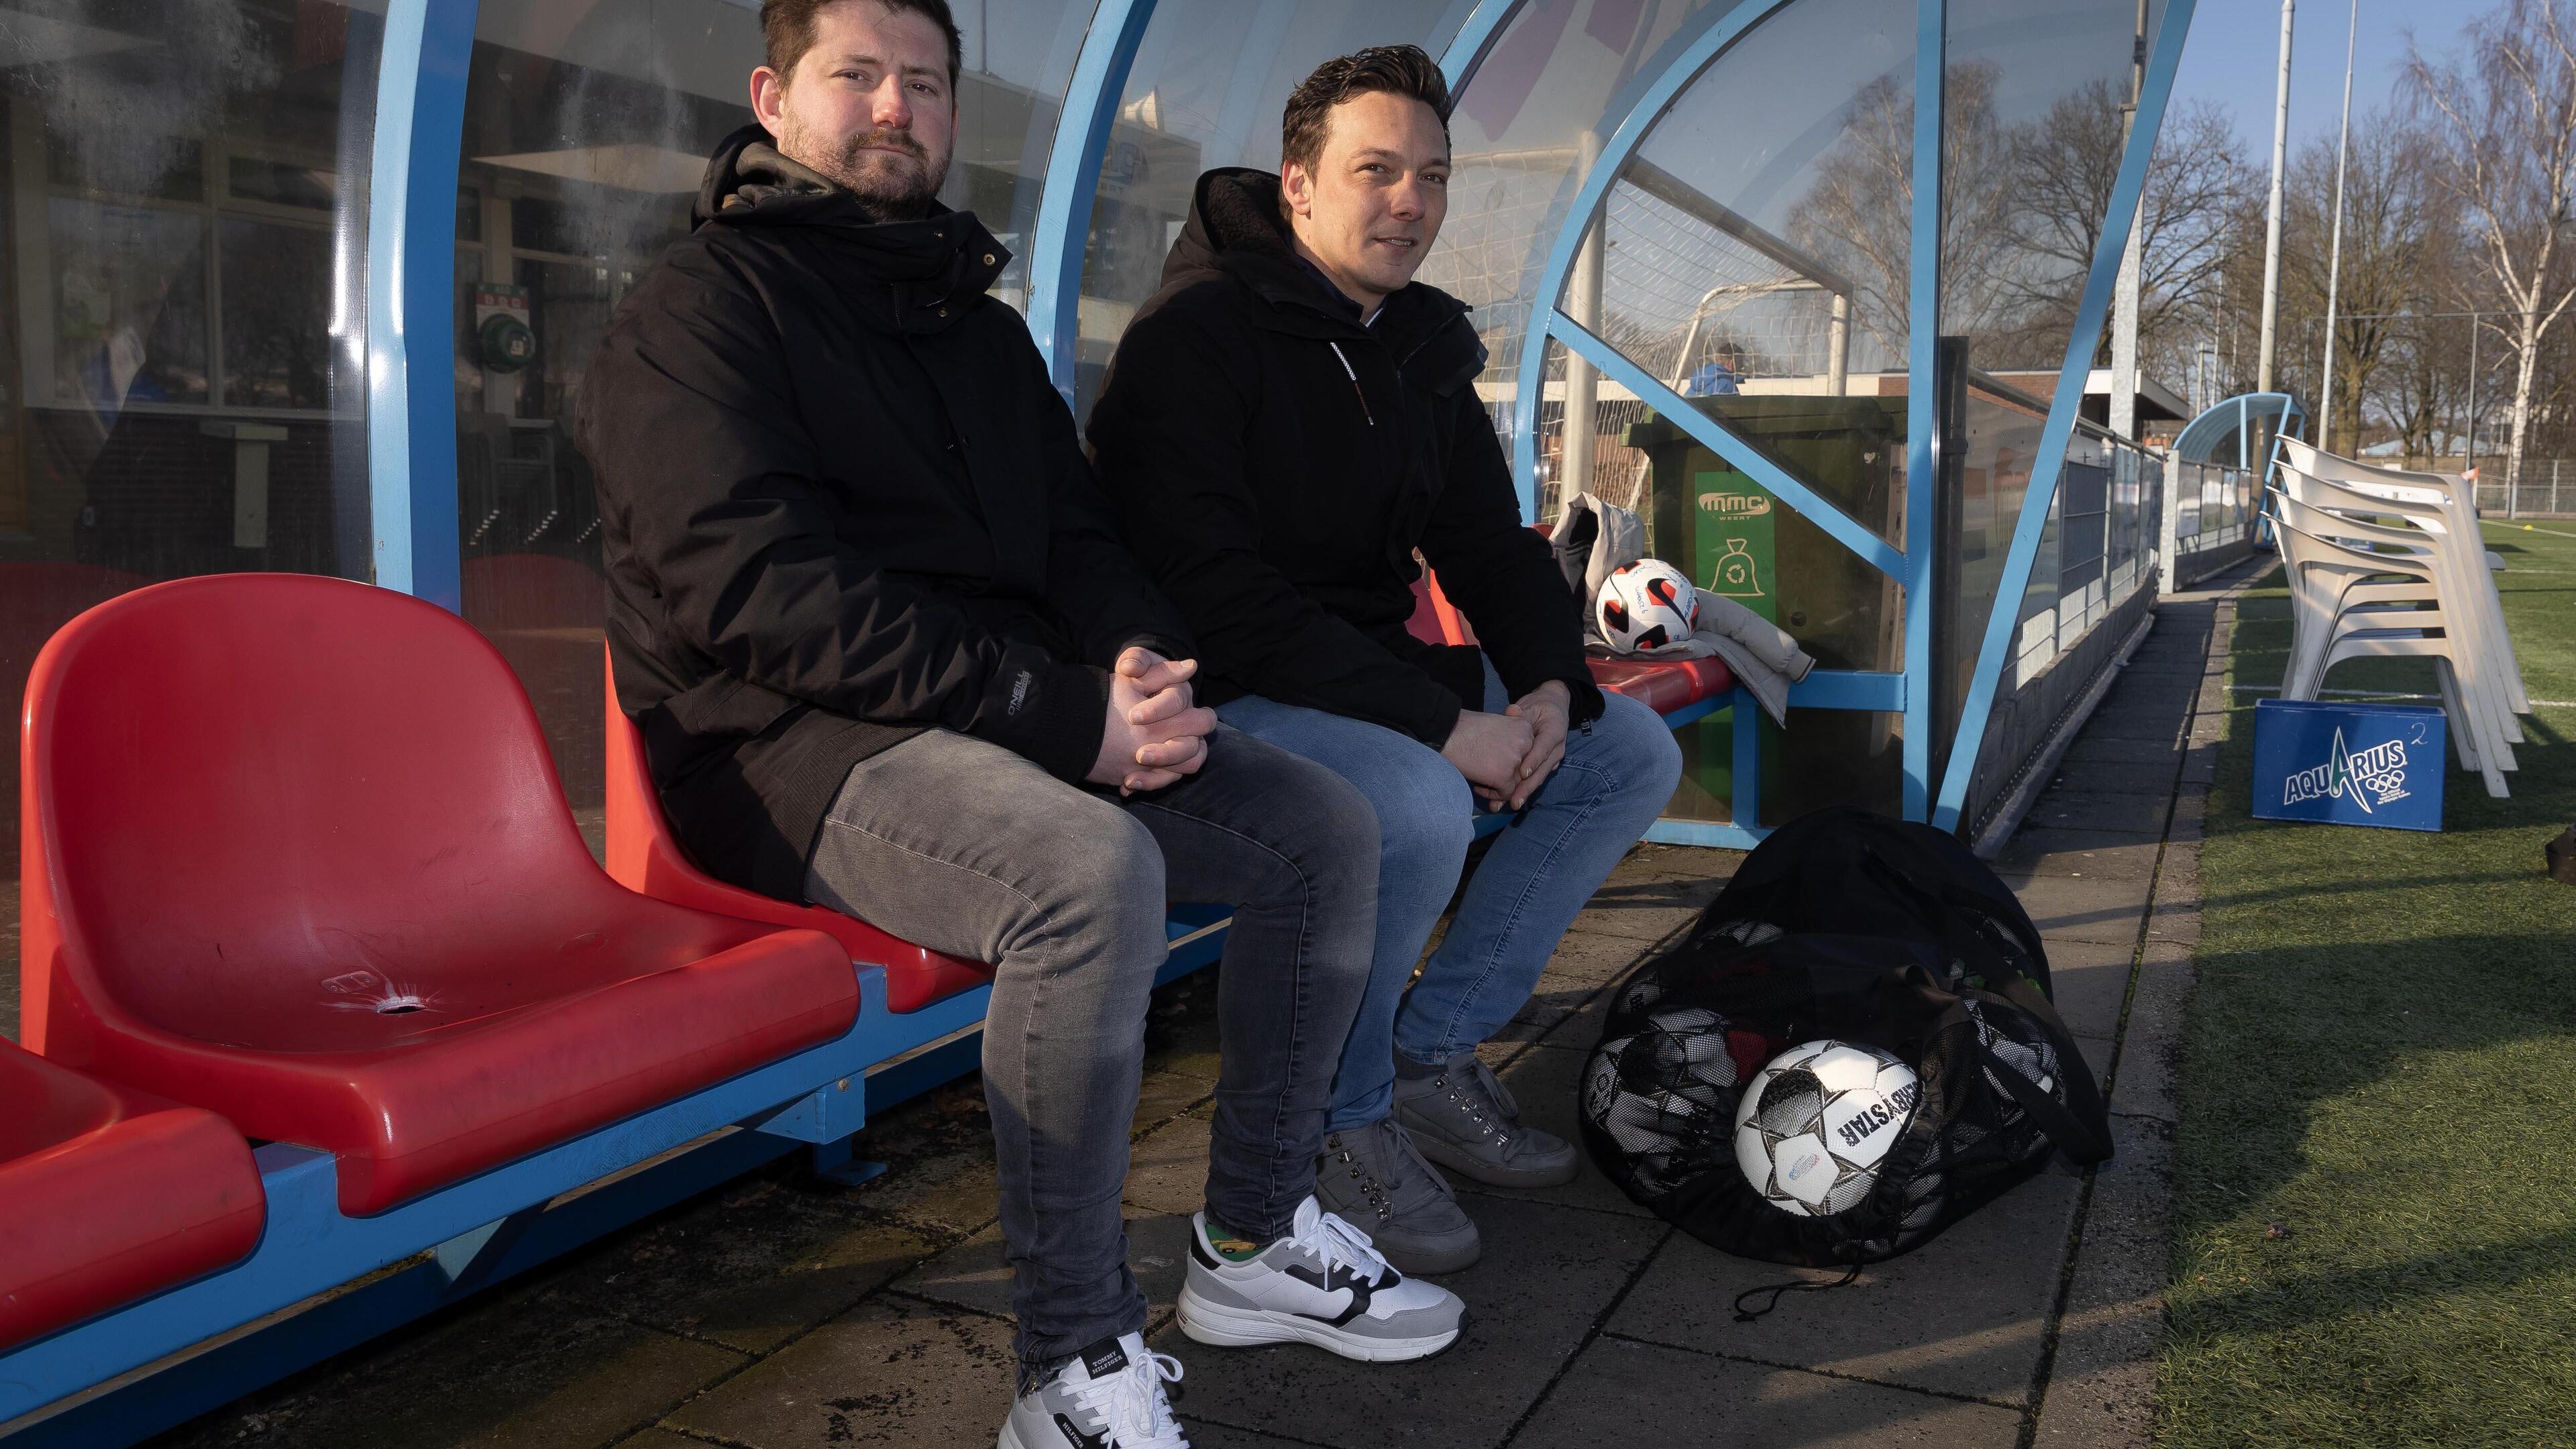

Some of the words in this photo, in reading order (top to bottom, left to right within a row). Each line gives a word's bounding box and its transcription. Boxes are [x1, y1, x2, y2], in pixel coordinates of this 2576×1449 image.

[1008, 670, 1026, 716] O'NEILL
[2411, 722, 2428, 745] 2
[2284, 725, 2408, 814] AQUARIUS
[1091, 1354, 1124, 1375] HILFIGER
[1092, 1350, 1117, 1367] TOMMY
[1063, 1422, 1084, 1449] HILFIGER
